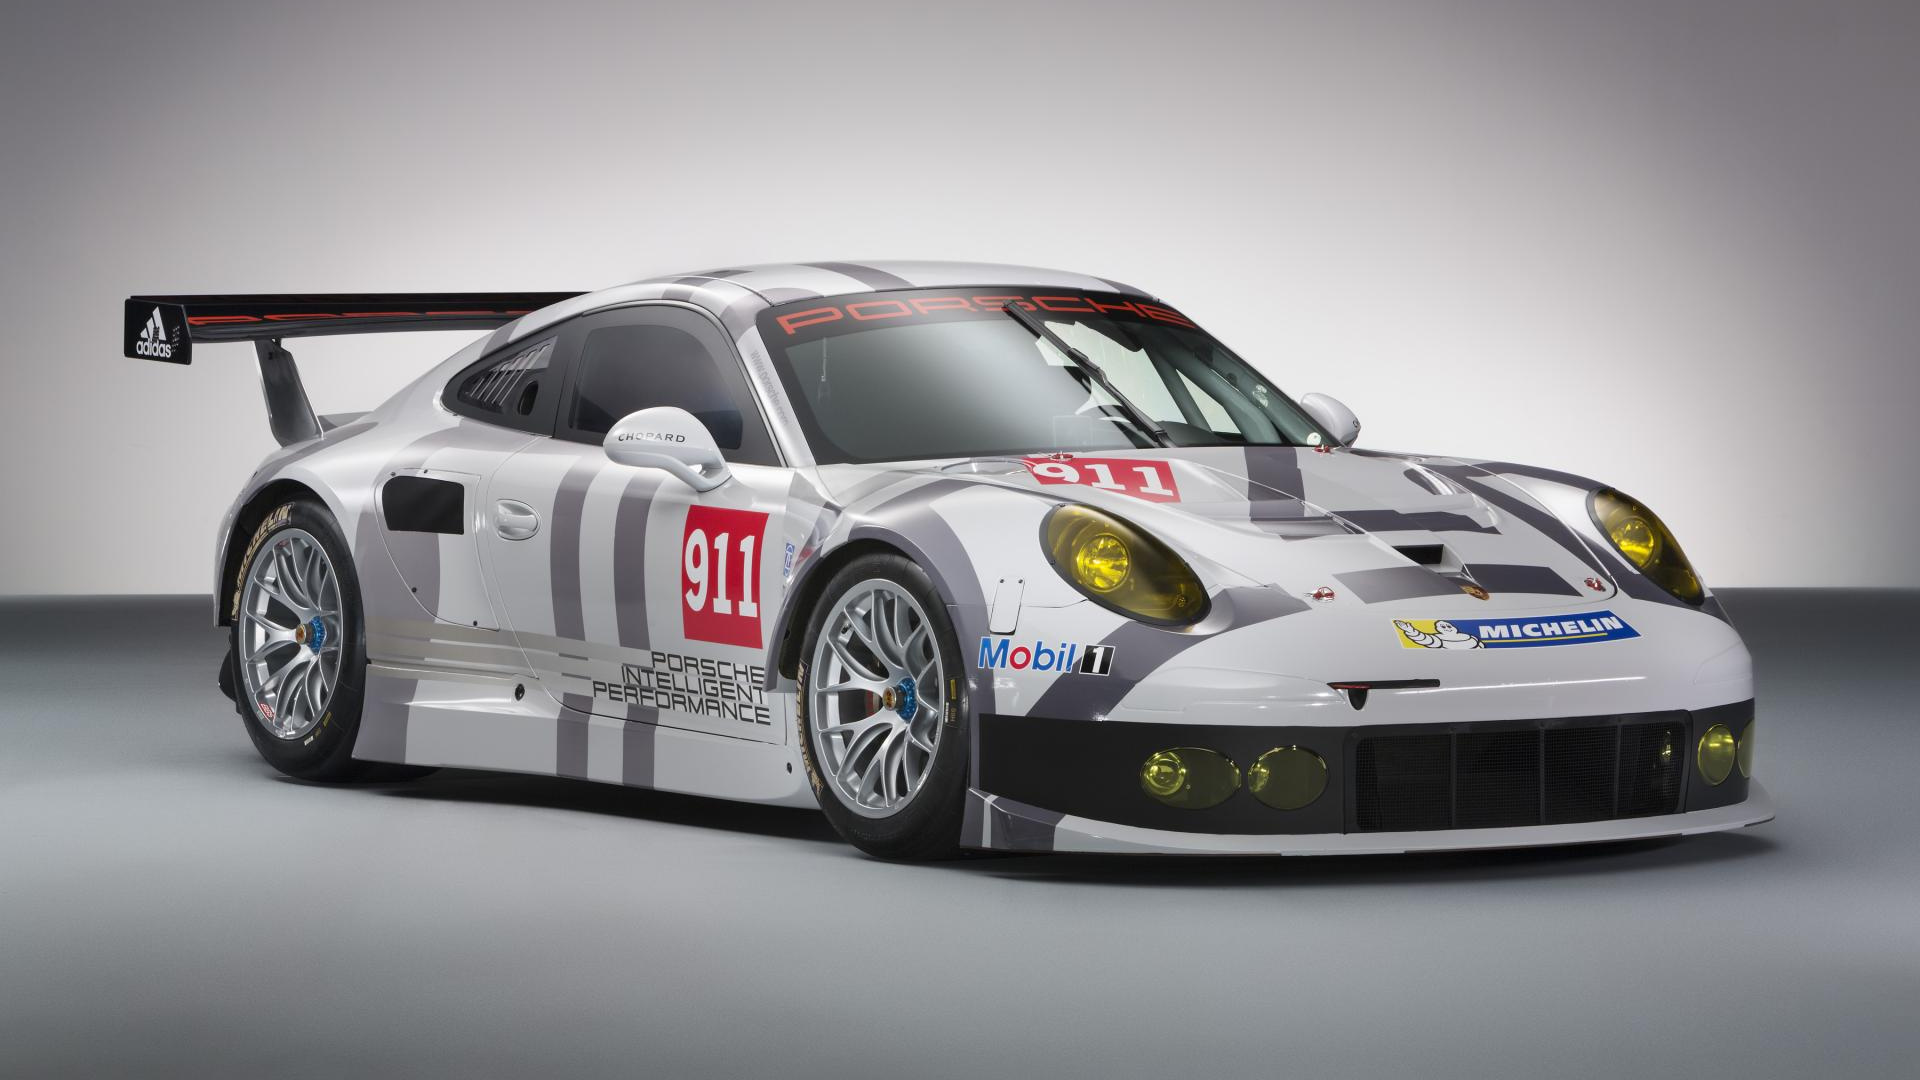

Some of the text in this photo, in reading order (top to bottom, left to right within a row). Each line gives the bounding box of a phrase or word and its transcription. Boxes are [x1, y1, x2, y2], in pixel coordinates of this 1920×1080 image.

[776, 296, 1196, 335] PORSCHE
[136, 338, 171, 358] adidas
[618, 432, 686, 443] CHOPARD
[1033, 463, 1173, 496] 911
[685, 528, 758, 618] 911
[1479, 616, 1624, 639] MICHELIN
[651, 651, 765, 684] PORSCHE
[978, 636, 1077, 672] Mobil
[621, 665, 764, 704] INTELLIGENT
[593, 680, 771, 726] PERFORMANCE
